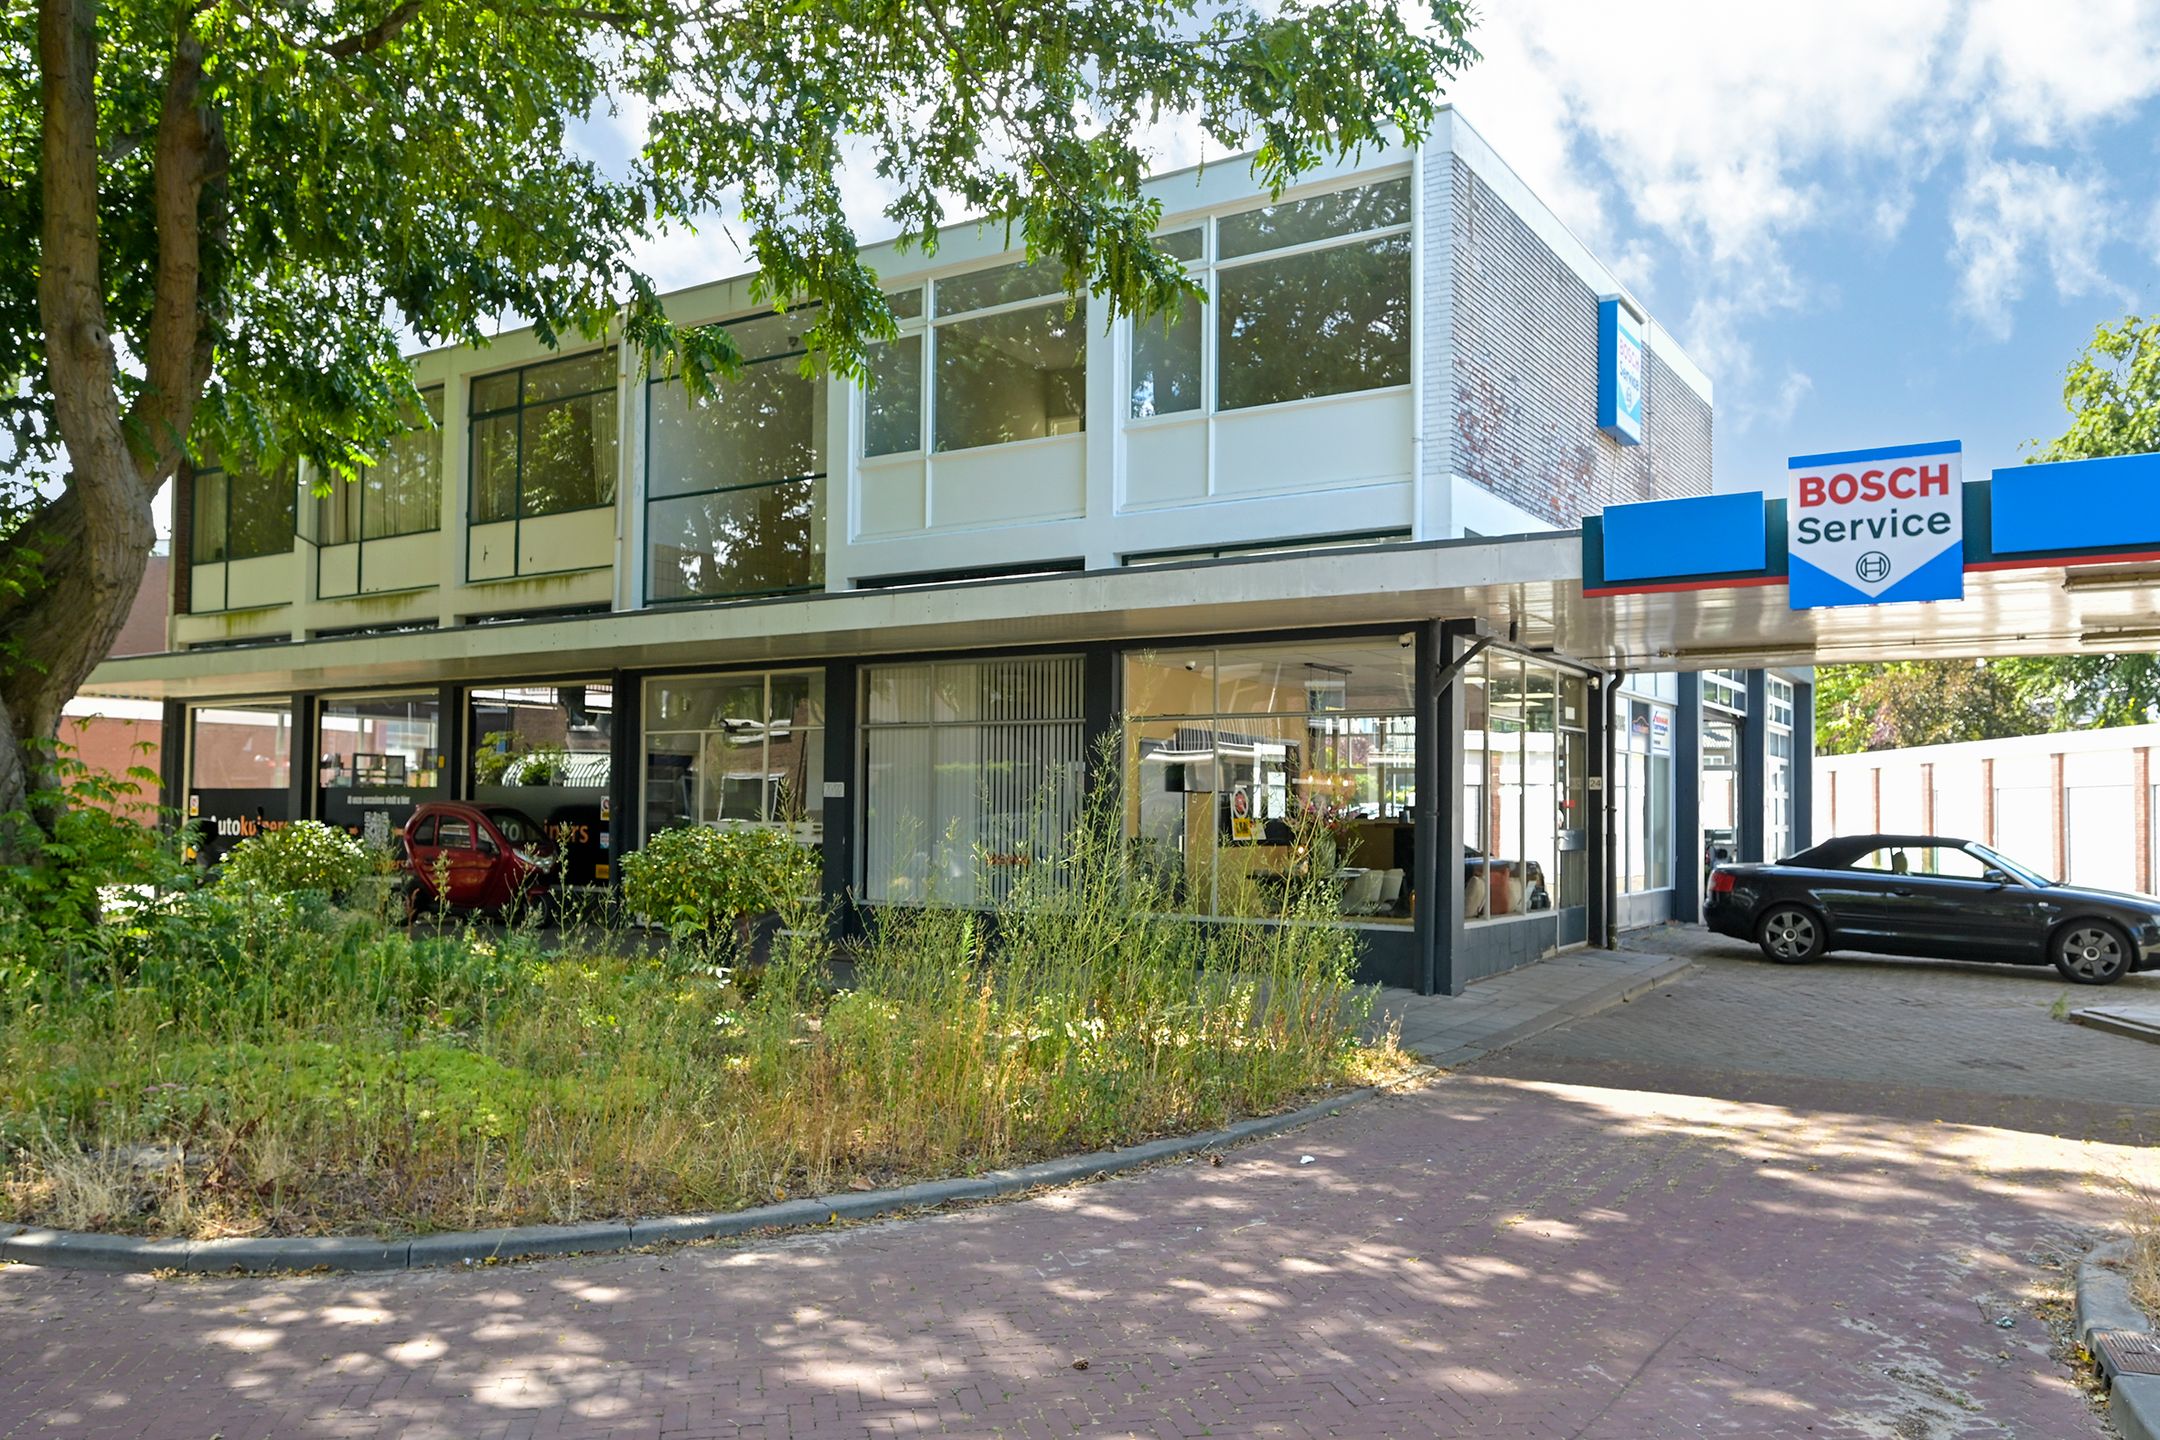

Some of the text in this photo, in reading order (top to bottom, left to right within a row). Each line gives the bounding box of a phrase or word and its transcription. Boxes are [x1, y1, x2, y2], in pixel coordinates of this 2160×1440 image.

[1619, 338, 1640, 374] BOSCH
[1619, 360, 1640, 392] Service
[1799, 463, 1949, 508] BOSCH
[1797, 508, 1951, 545] Service
[1590, 778, 1601, 788] 24
